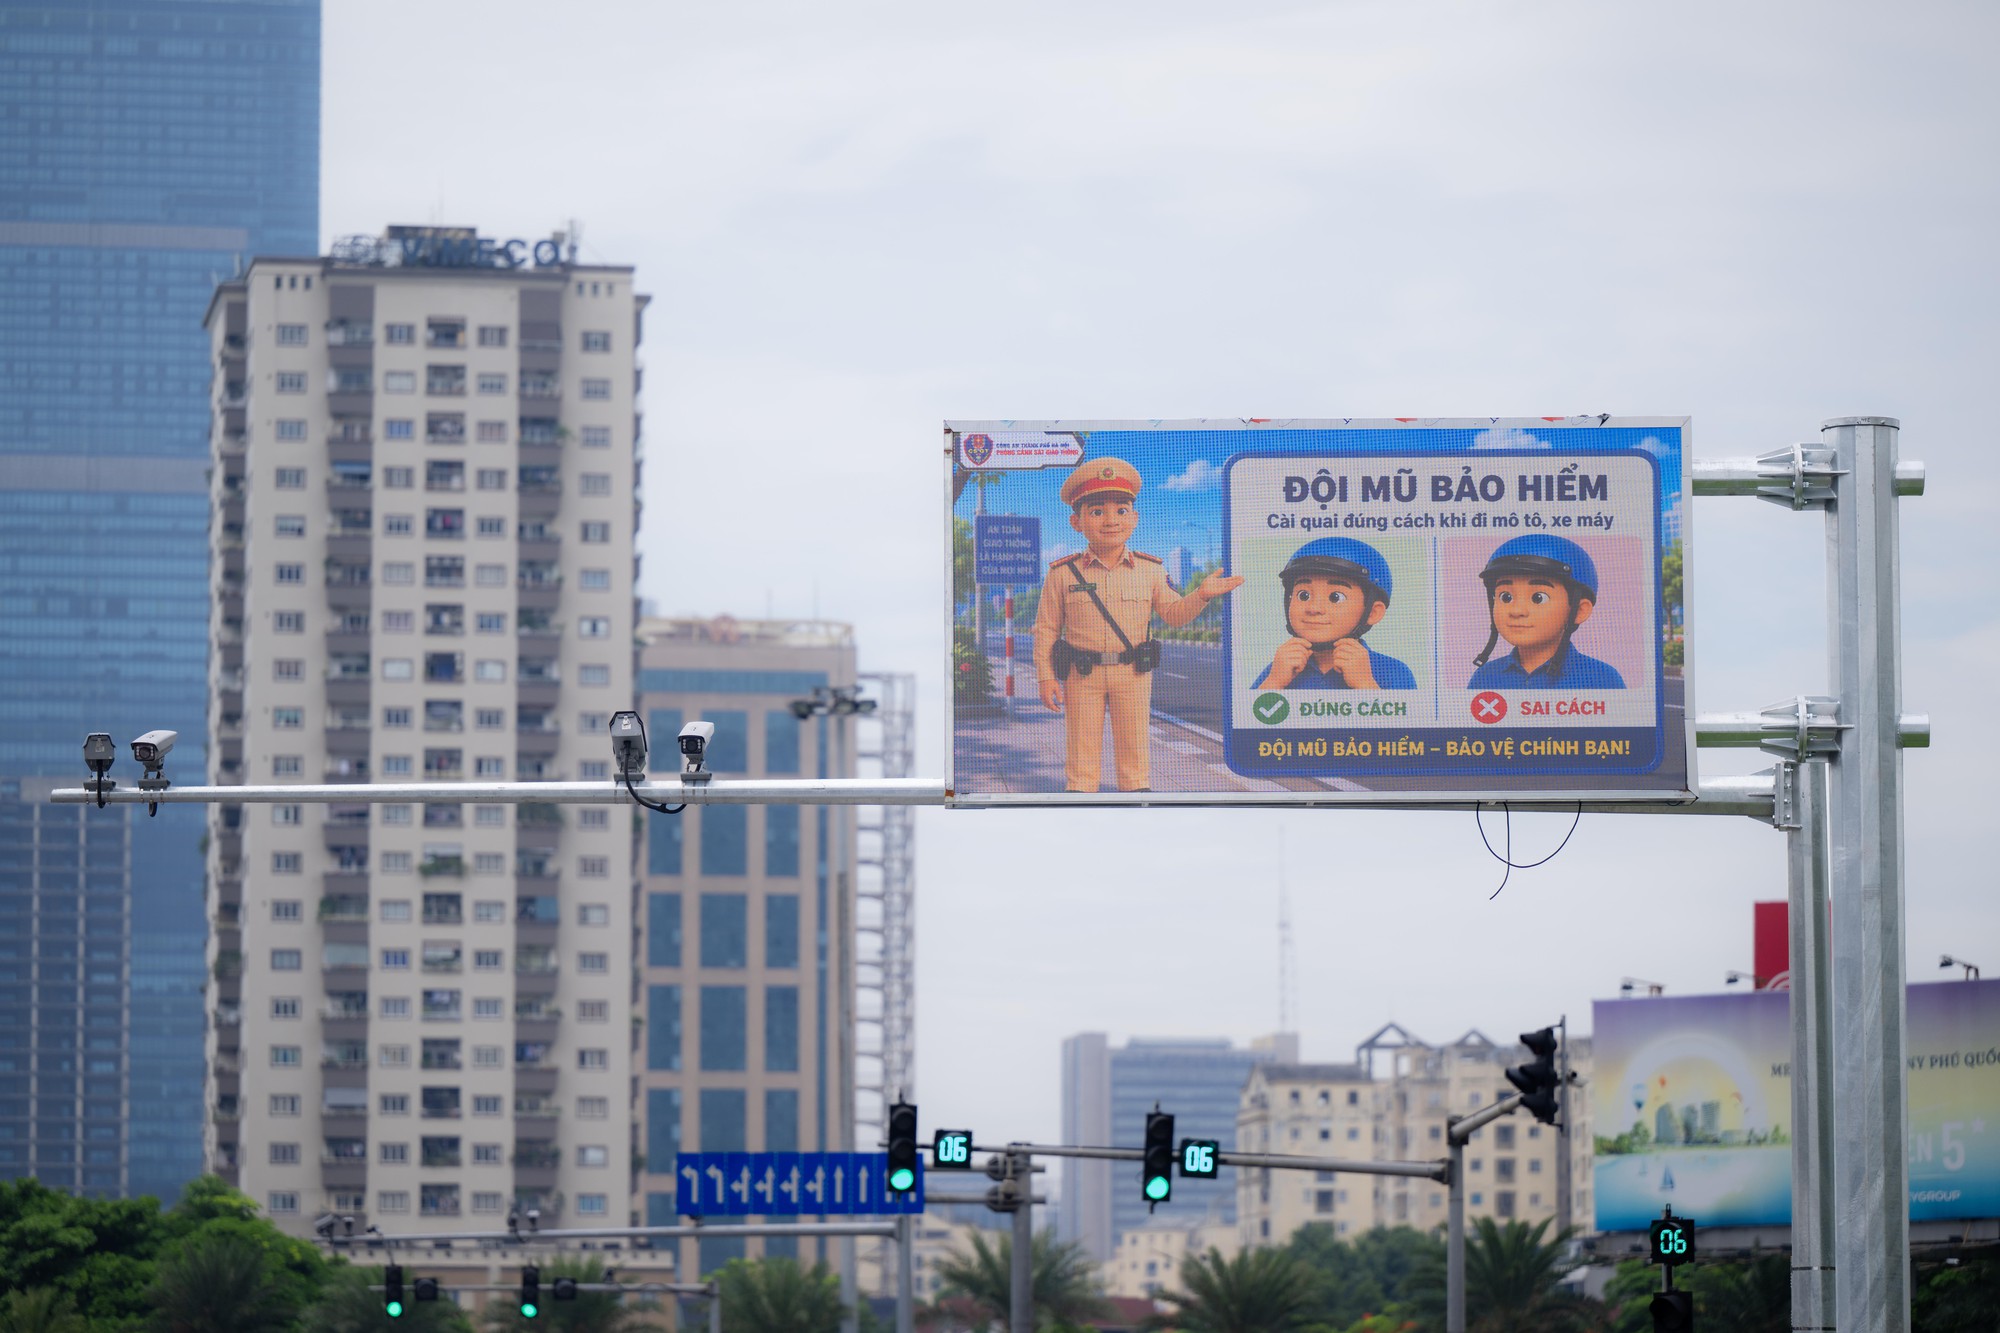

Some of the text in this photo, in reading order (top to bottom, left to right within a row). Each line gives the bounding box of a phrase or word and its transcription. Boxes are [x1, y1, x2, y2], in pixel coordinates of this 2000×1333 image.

[1283, 463, 1608, 510] ĐỘI MŨ BẢO HIỂM
[1267, 512, 1614, 532] Cài quai đúng cách khi đi mô tô, xe máy
[1300, 699, 1407, 716] ĐÚNG CÁCH
[1520, 697, 1605, 715] SAI CÁCH
[1258, 738, 1292, 760] ĐỘI
[1298, 738, 1327, 756] MŨ
[1333, 736, 1372, 756] BẢO
[1378, 735, 1424, 756] HIỂM
[1446, 736, 1486, 756] BẢO
[1491, 737, 1514, 759] VỆ
[1520, 737, 1579, 755] CHÍNH
[1585, 740, 1630, 759] BẠN!
[1930, 1051, 1960, 1069] PHÚ
[1964, 1047, 2000, 1069] QUỐ
[939, 1136, 967, 1162] 06
[1185, 1145, 1213, 1172] 06
[1909, 1189, 1961, 1203] YGROUP
[1660, 1229, 1687, 1254] 06
